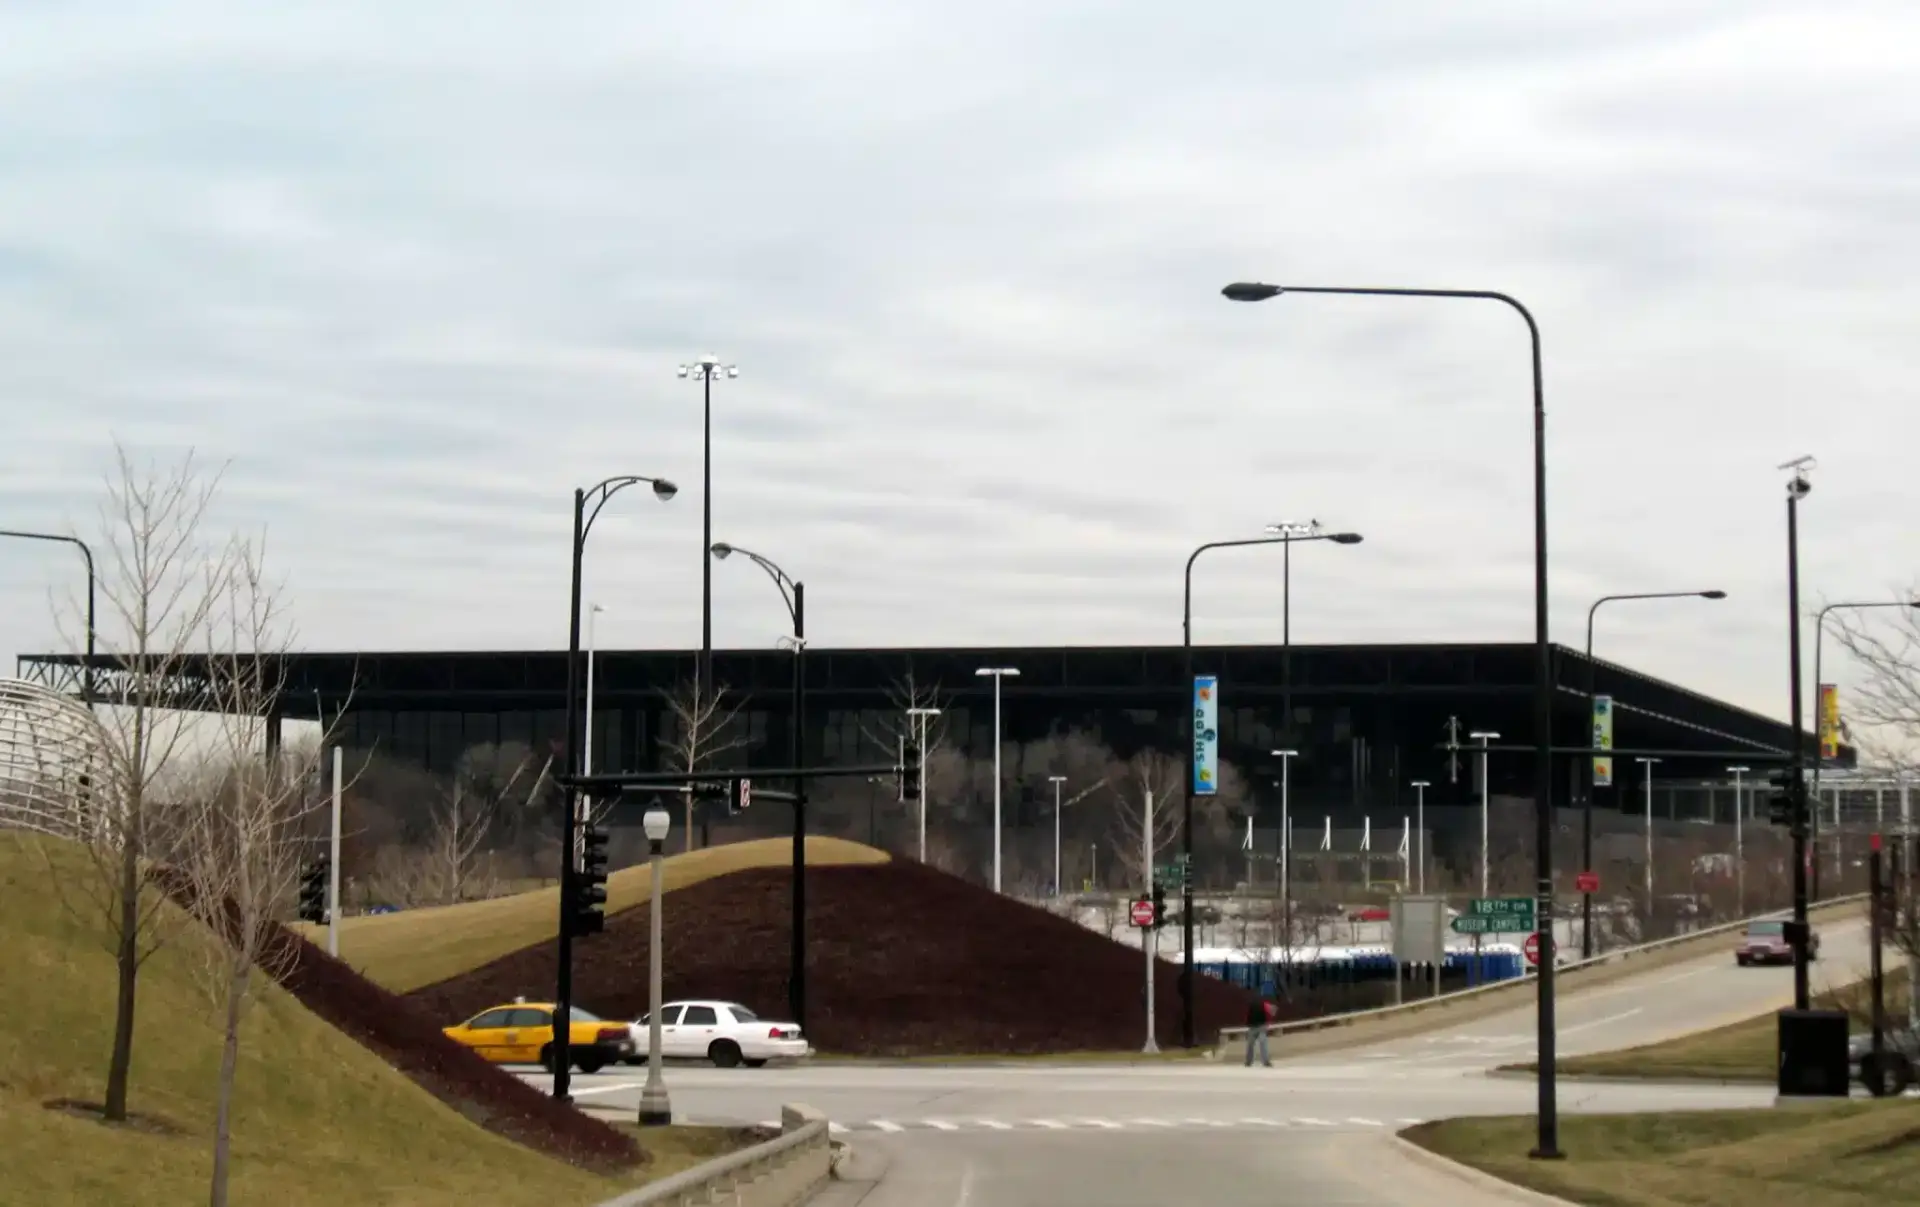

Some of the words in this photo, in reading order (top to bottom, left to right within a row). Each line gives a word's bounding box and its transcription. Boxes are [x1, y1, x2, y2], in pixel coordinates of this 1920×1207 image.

[1195, 708, 1205, 763] SHEDD
[1476, 901, 1508, 913] 18TH
[1457, 918, 1487, 931] MUSEUM
[1492, 918, 1520, 931] CAMPUS
